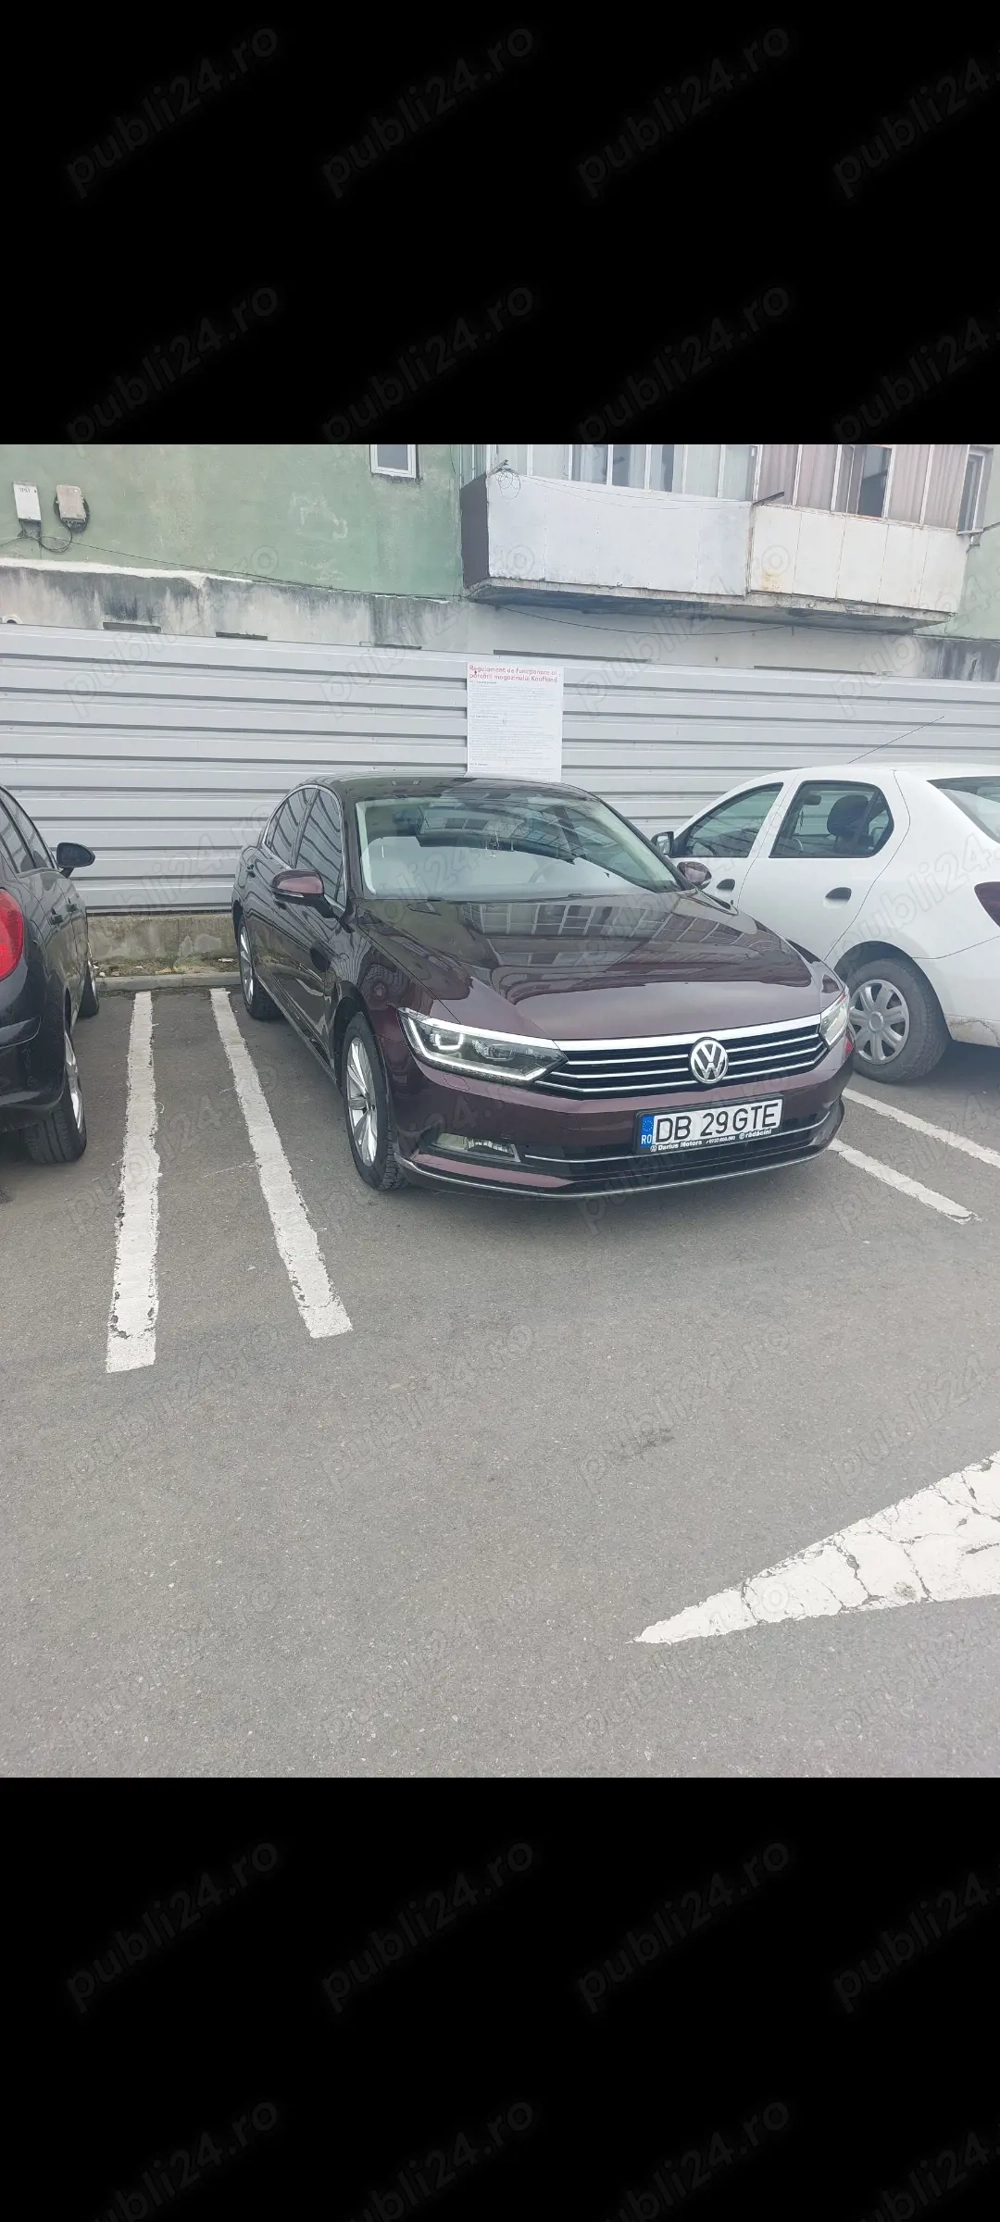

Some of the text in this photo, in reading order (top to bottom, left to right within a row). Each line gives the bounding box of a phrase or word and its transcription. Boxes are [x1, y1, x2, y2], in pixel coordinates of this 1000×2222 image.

[469, 664, 506, 673] Regulament
[531, 675, 558, 683] Kaufland
[656, 1103, 780, 1143] DB 29 GTE
[641, 1134, 652, 1145] RO
[658, 1143, 679, 1151] Darius
[680, 1140, 703, 1148] Motors
